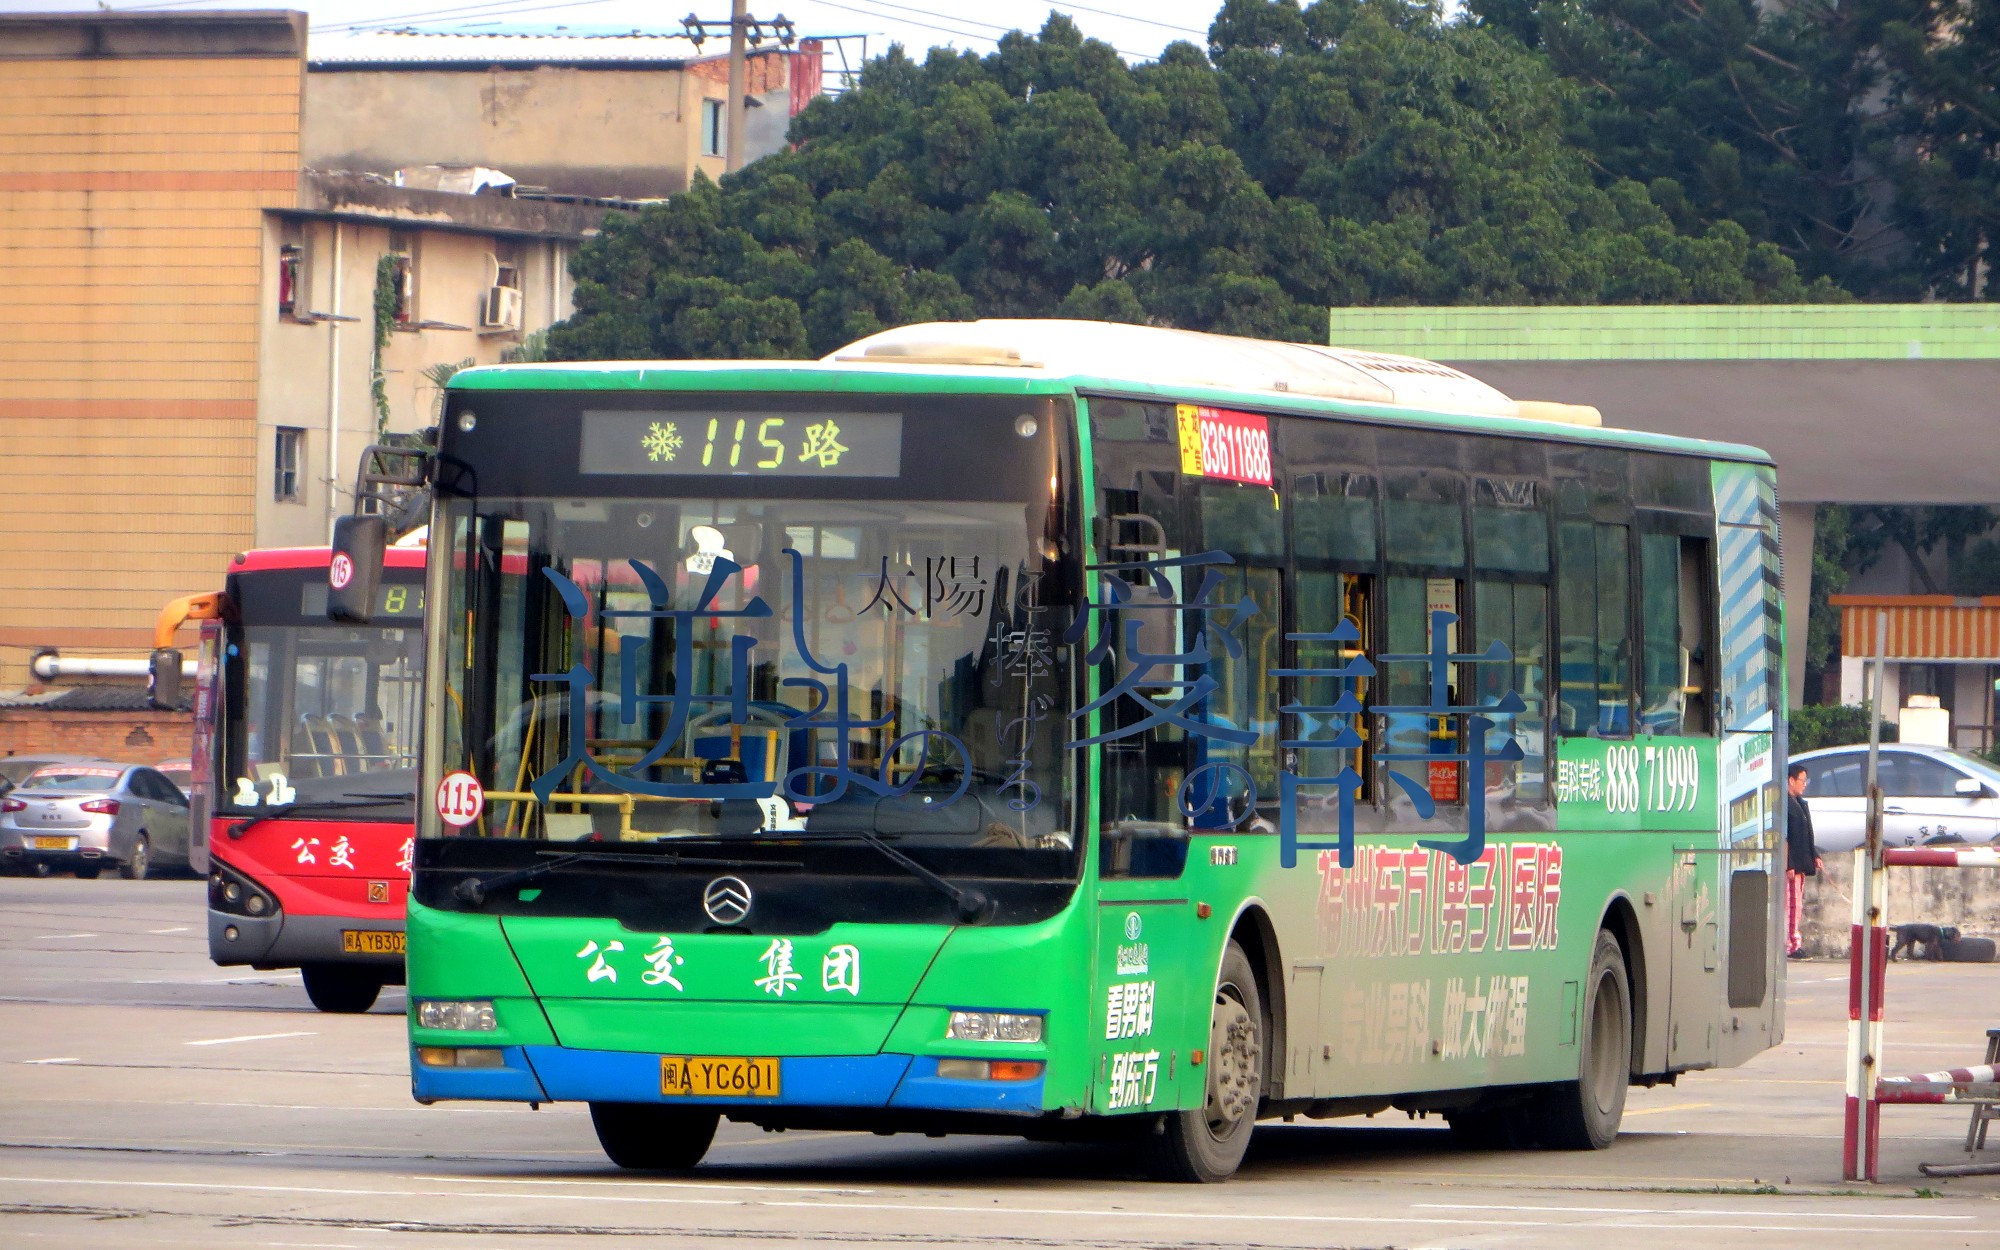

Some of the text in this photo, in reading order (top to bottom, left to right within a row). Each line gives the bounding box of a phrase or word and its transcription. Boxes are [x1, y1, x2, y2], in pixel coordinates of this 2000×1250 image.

[702, 418, 849, 468] 115路
[1200, 420, 1271, 482] 83611888
[333, 559, 348, 584] 115
[441, 781, 478, 817] 115
[1106, 980, 1155, 1040] 看男科
[664, 1063, 772, 1090] 闽A·YC601
[1109, 1048, 1160, 1109] 到东方
